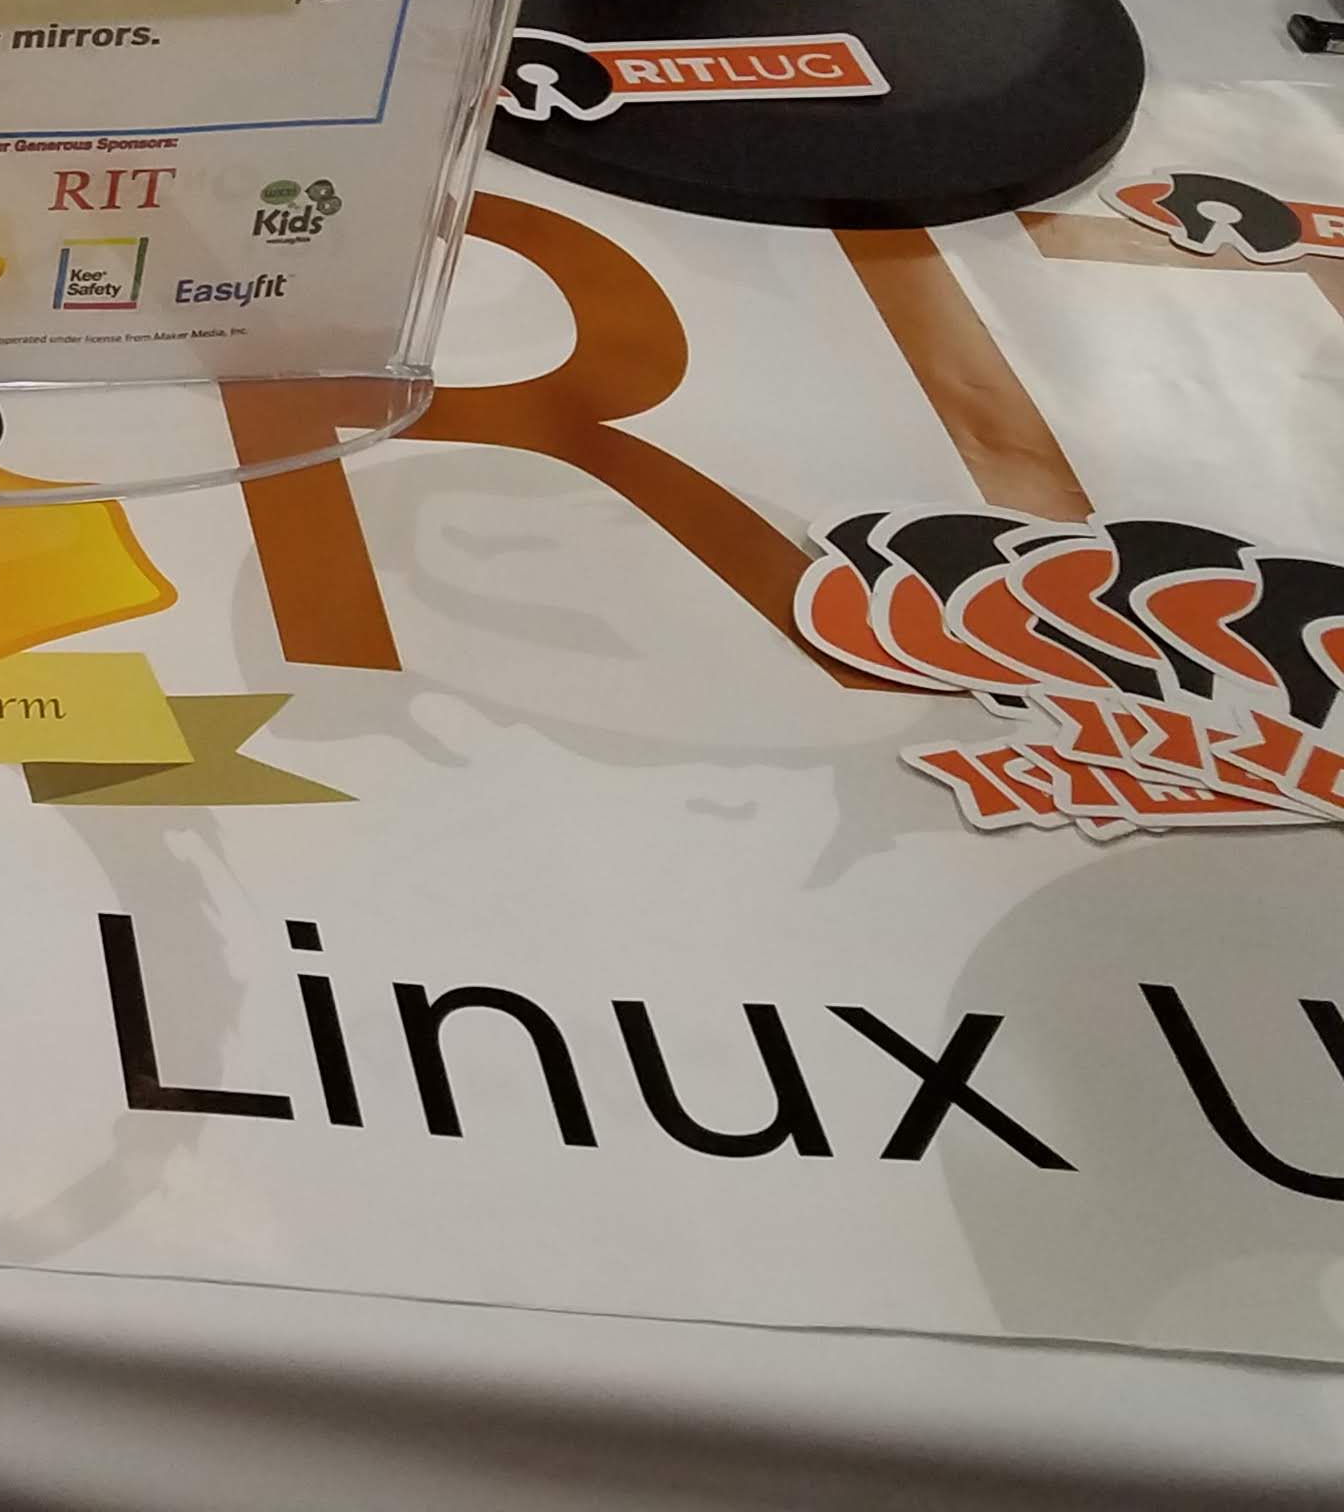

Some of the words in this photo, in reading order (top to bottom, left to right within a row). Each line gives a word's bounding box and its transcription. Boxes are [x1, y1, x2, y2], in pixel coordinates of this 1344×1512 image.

[13, 20, 161, 51] mirrors.
[613, 47, 846, 86] RITLUG
[15, 139, 92, 154] Generous
[96, 138, 178, 154] Sponsors:
[47, 167, 178, 212] RIT
[252, 204, 325, 236] Kids
[67, 281, 122, 298] Safety
[70, 268, 99, 282] Kee
[175, 274, 288, 307] Easyfit
[97, 912, 1078, 1175] Linux
